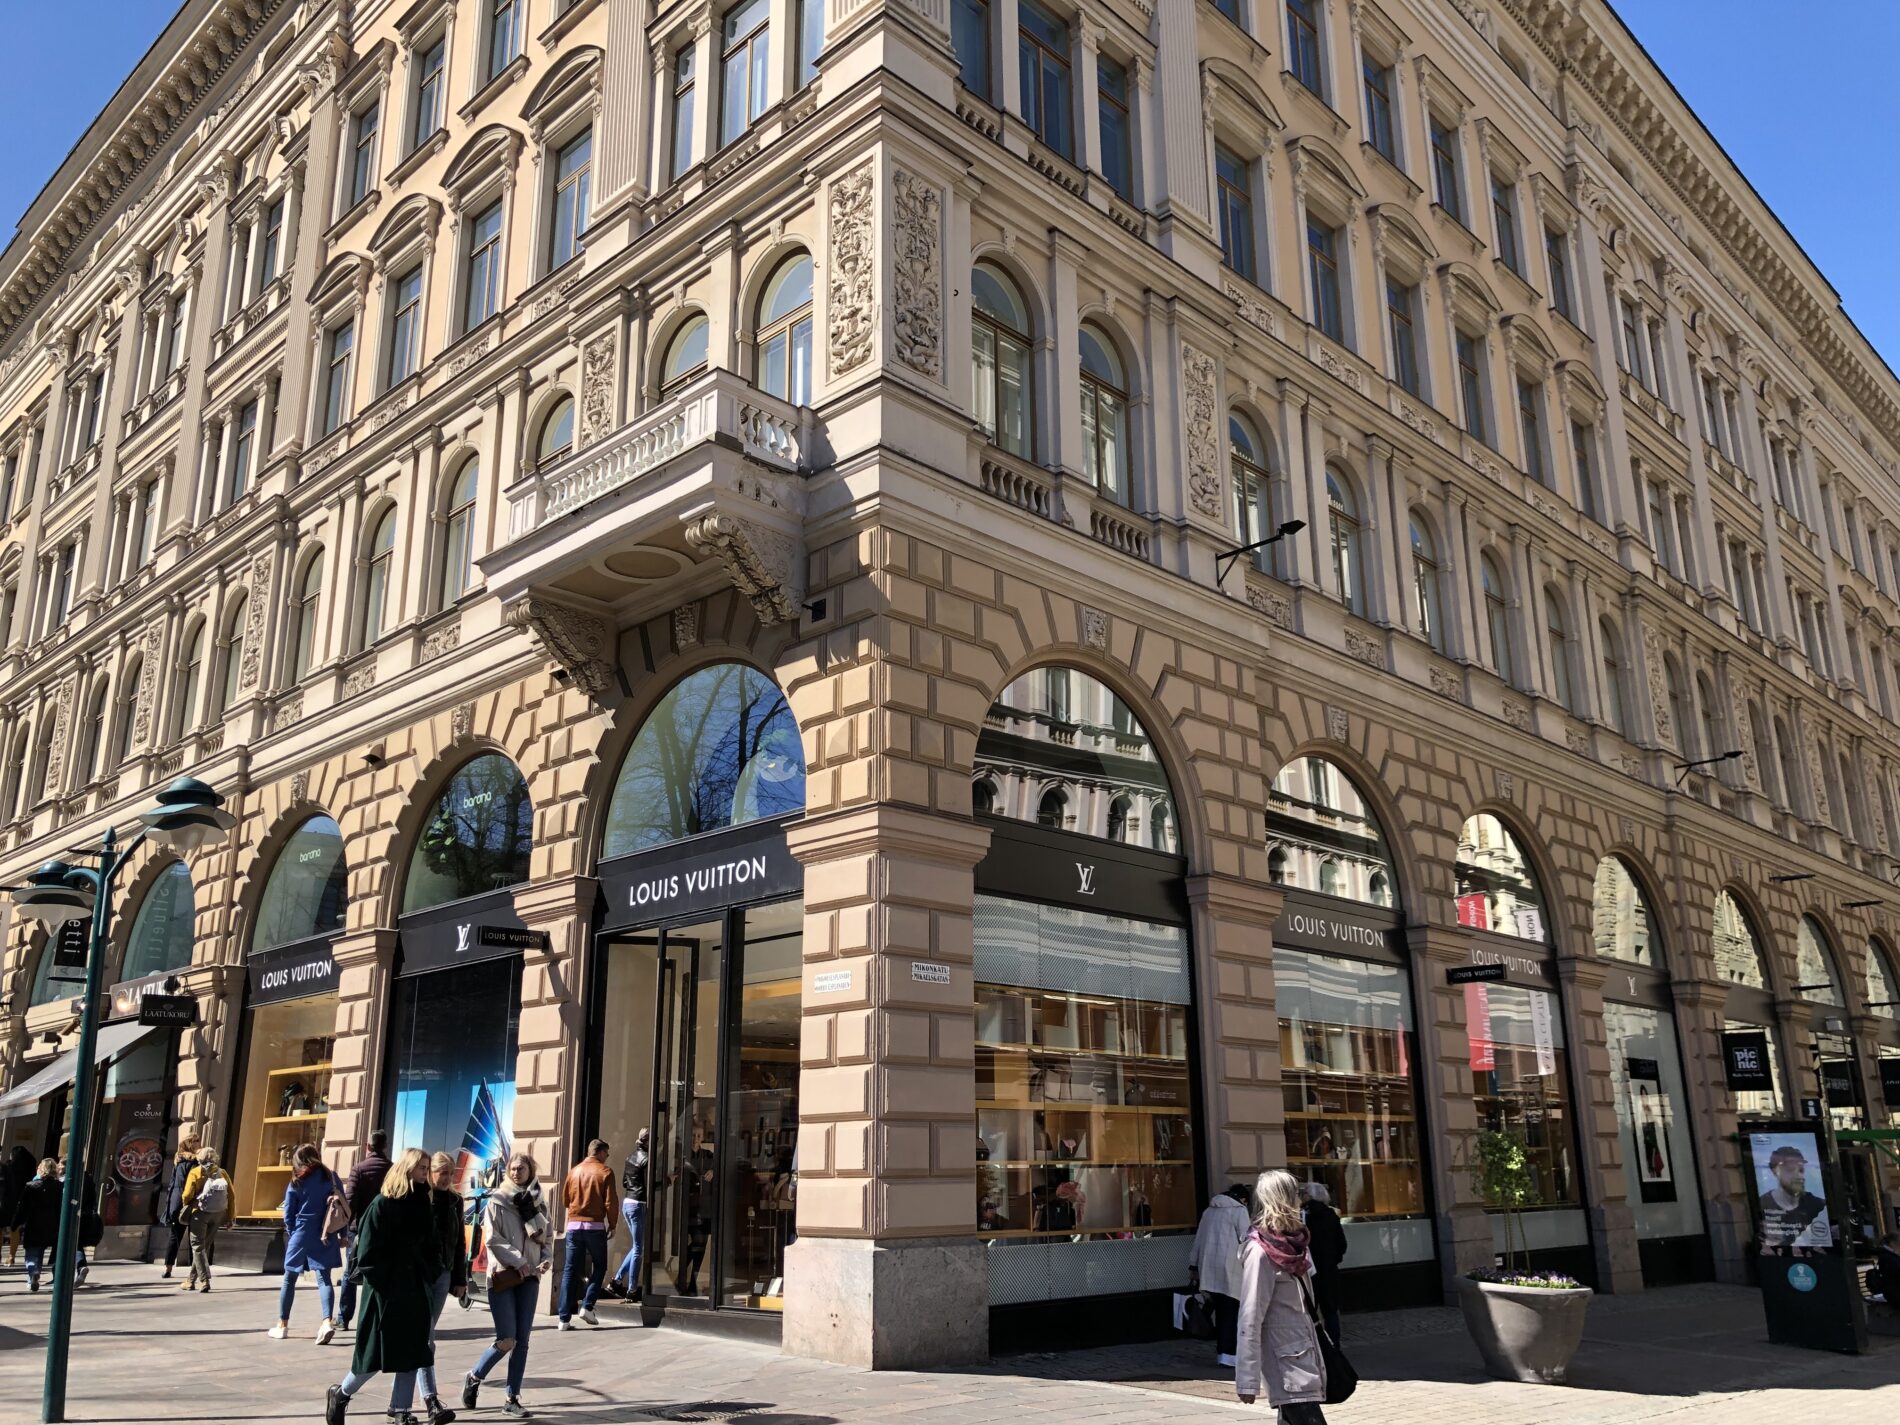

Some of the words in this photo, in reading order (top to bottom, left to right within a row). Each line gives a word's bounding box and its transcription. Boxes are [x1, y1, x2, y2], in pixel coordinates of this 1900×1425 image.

[629, 875, 680, 907] LOUIS
[685, 855, 766, 891] VUITTON
[63, 919, 83, 954] etti
[484, 931, 506, 941] LOUIS
[509, 934, 541, 944] VUITTON
[1288, 913, 1326, 938] LOUIS
[1330, 921, 1385, 948] VUITTON
[914, 963, 949, 974] MIKONKATU
[1471, 948, 1500, 966] LOUIS
[1501, 955, 1541, 977] VUITTON
[261, 966, 288, 989] LOUIS
[291, 959, 333, 982] VUITTON
[145, 1010, 190, 1018] LAATUKORU
[1735, 1048, 1756, 1061] pic
[1737, 1058, 1758, 1069] nic
